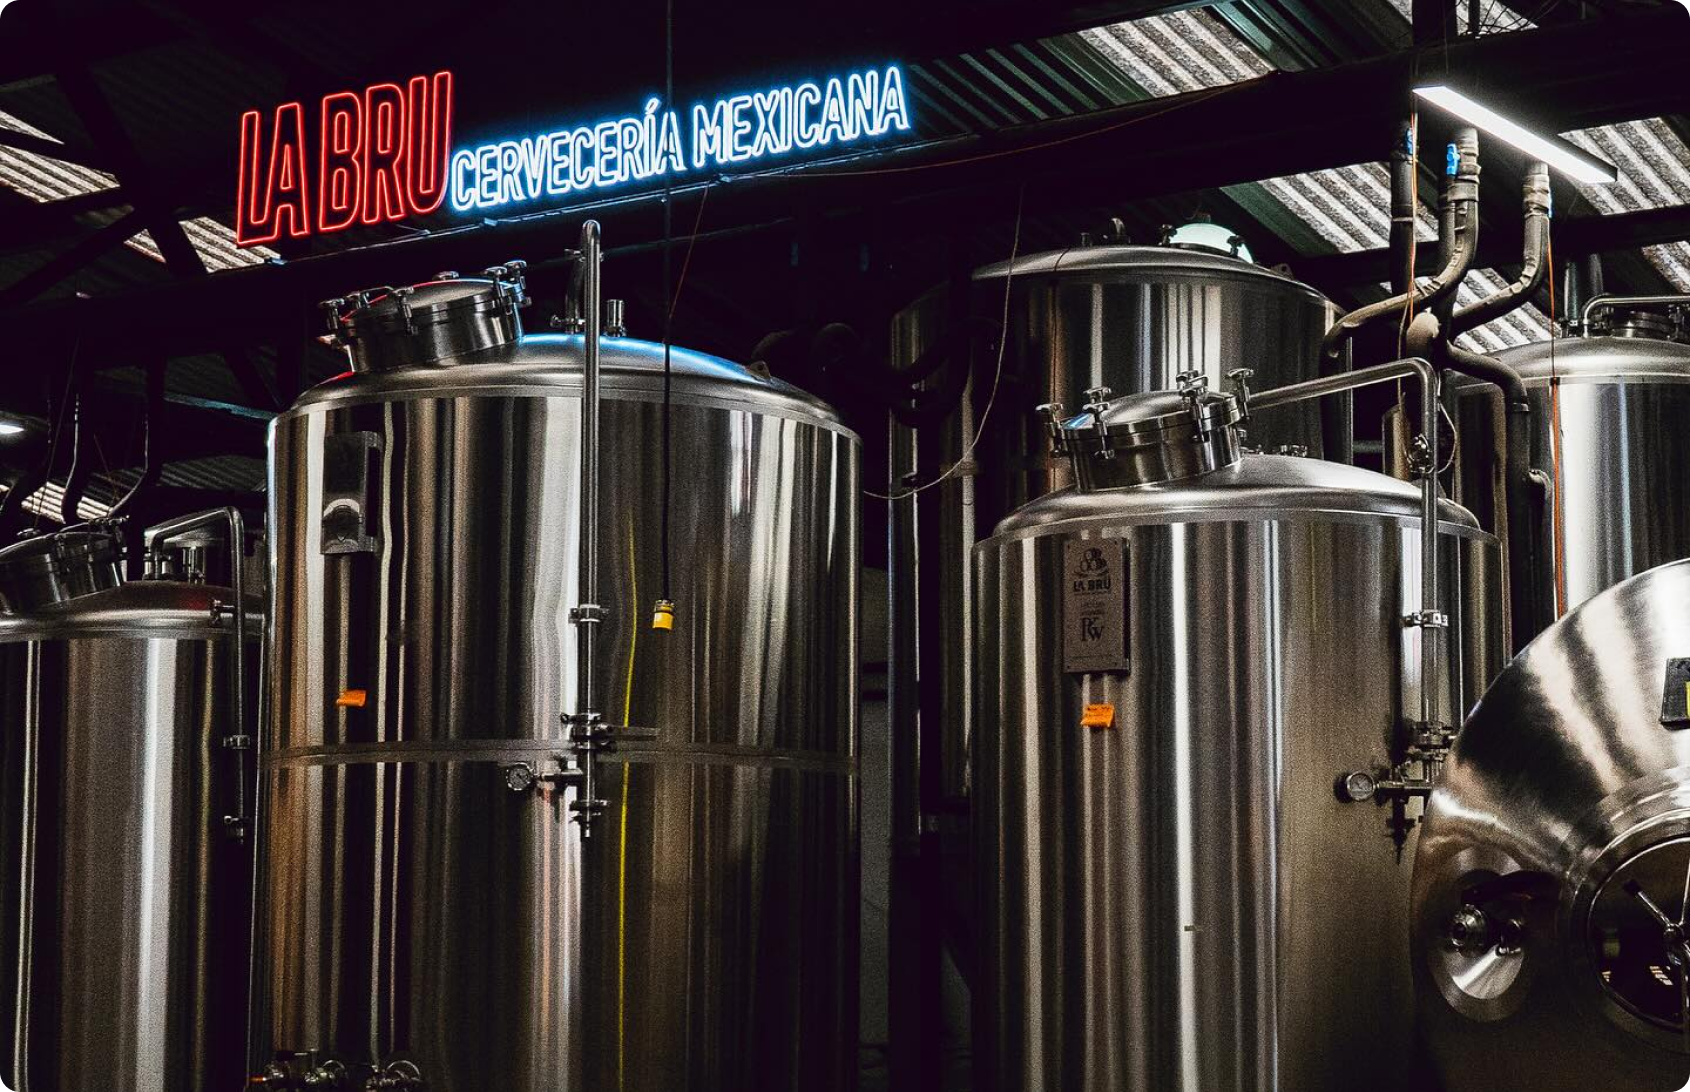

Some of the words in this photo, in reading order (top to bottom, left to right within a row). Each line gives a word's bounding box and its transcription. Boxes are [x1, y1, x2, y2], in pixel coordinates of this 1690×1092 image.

[236, 101, 309, 246] LA
[318, 71, 454, 230] BRU
[451, 98, 685, 211] CERVECERÍA
[692, 65, 911, 165] MEXICANA
[1073, 580, 1086, 592] LA
